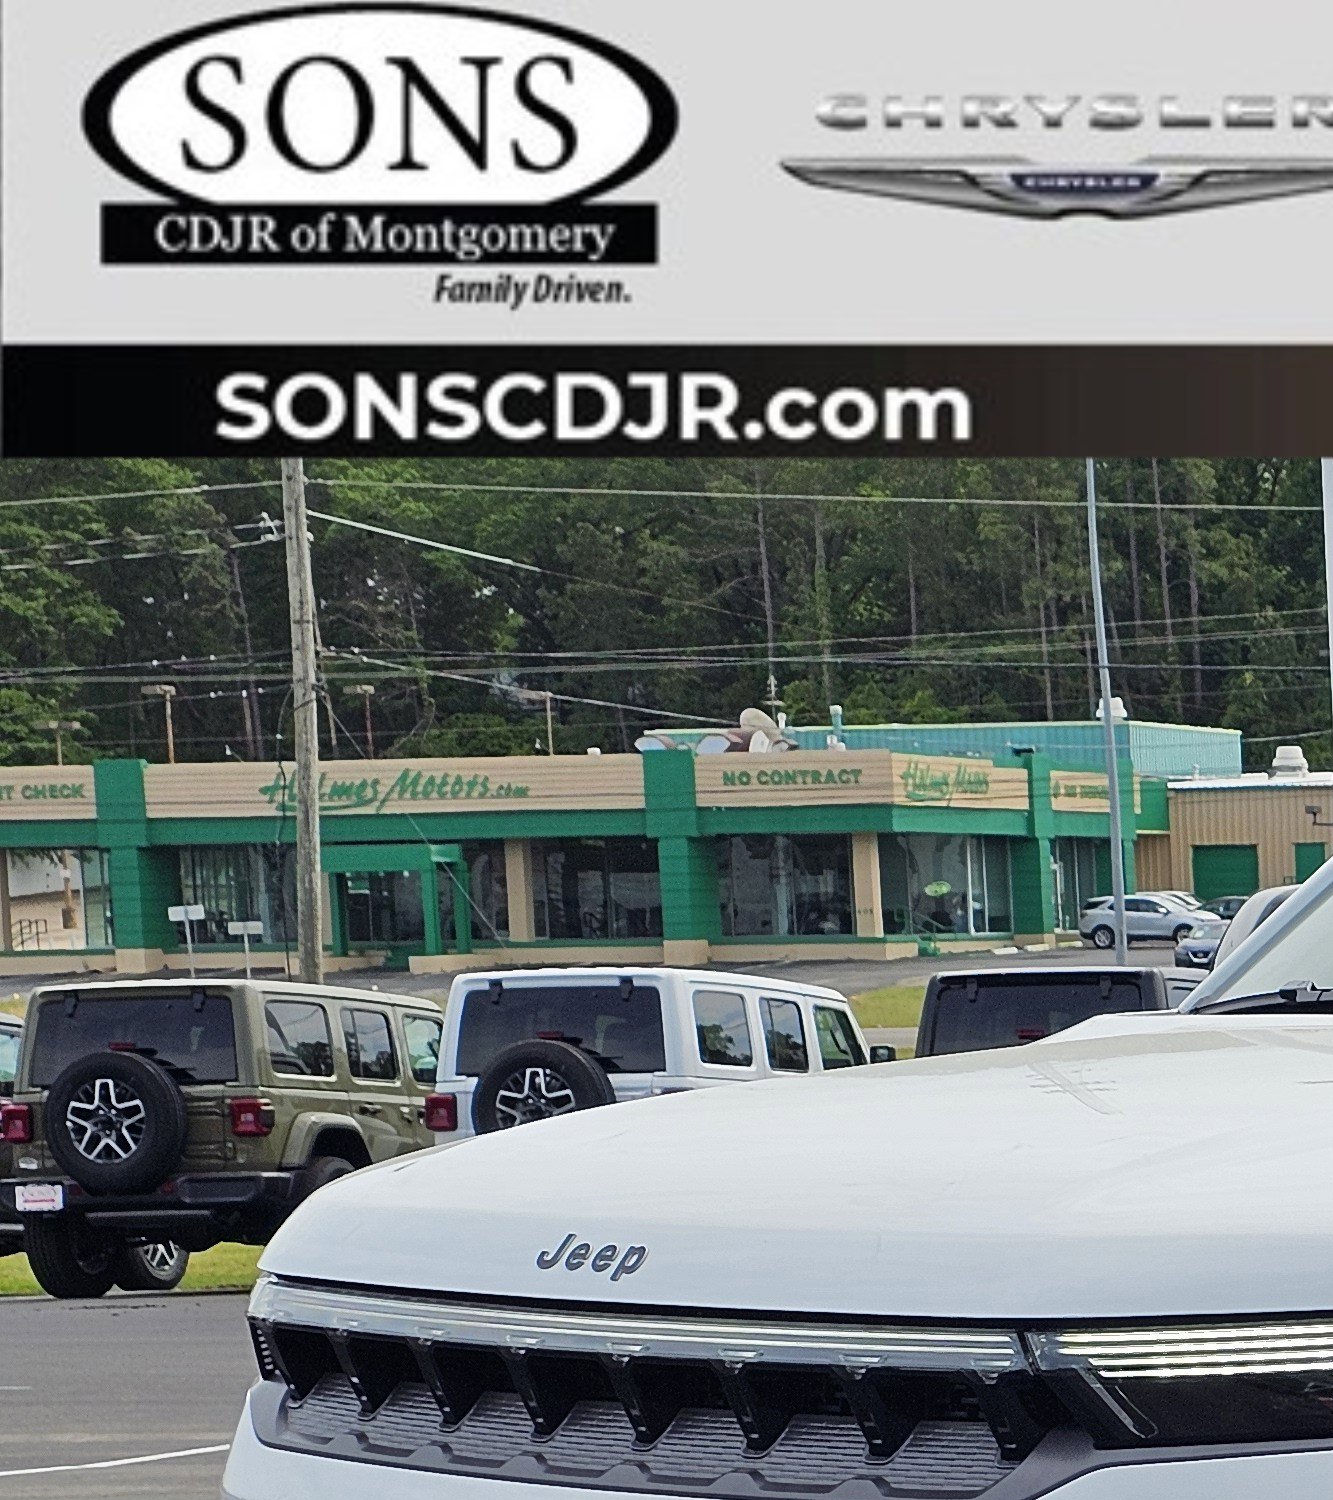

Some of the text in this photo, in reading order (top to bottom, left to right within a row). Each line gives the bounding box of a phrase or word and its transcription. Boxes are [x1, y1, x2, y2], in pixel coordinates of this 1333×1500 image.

[21, 783, 86, 800] CHECK
[259, 771, 380, 811] Hlmes
[722, 768, 863, 786] NO CONTRACT
[536, 1233, 649, 1282] Jeep
